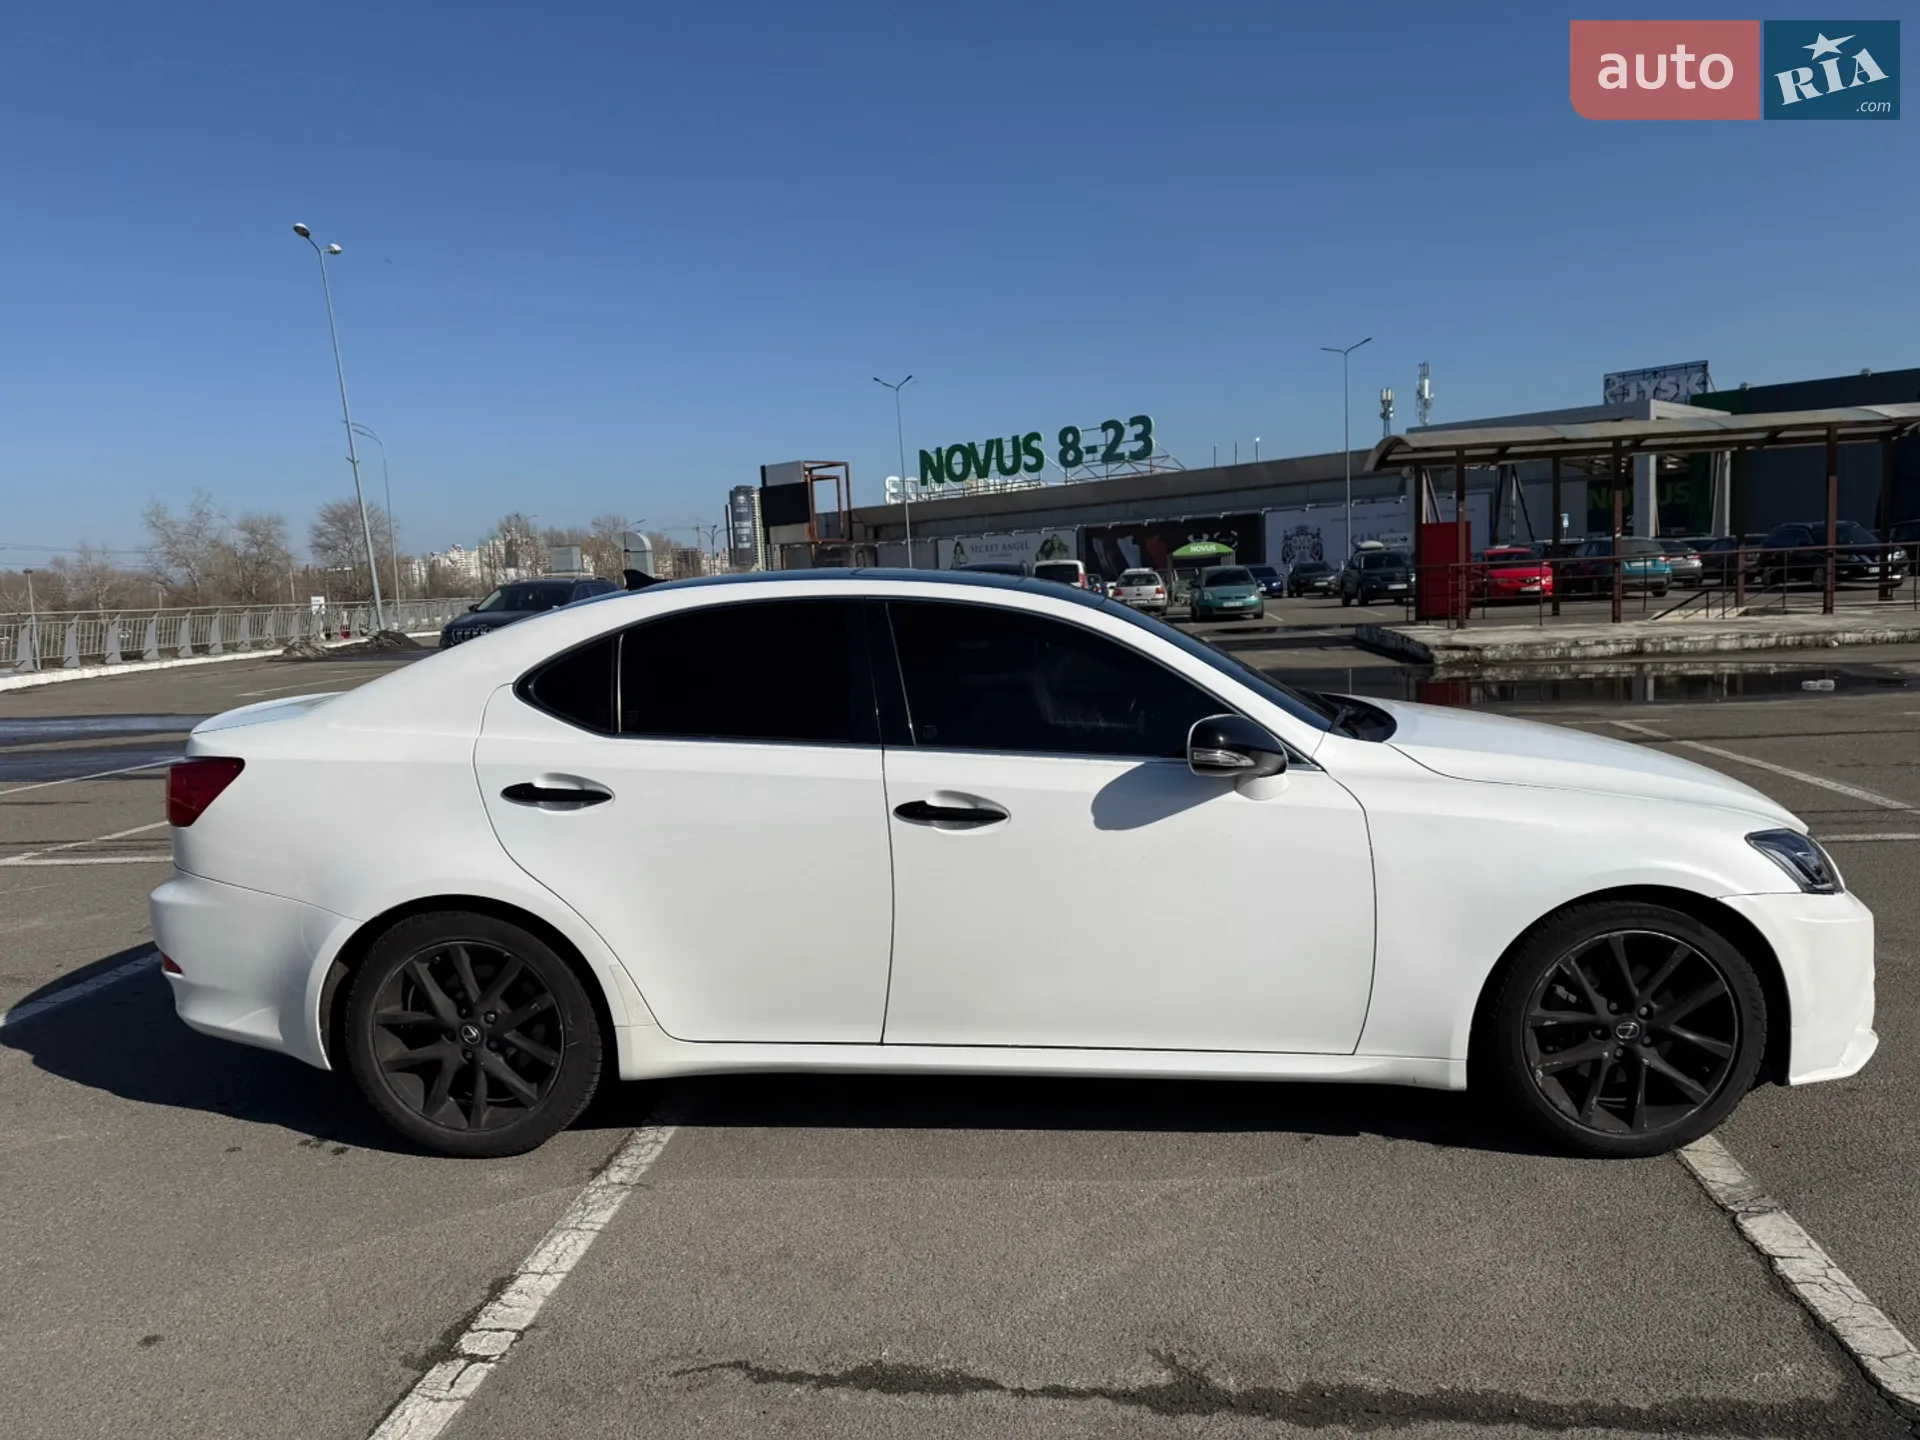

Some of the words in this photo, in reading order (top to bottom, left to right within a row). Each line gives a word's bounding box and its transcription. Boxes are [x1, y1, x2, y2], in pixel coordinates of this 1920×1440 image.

[1624, 372, 1703, 403] JYSK
[919, 431, 1045, 487] NOVUS
[1058, 415, 1154, 469] 8-23
[1588, 480, 1691, 511] NOUS
[970, 543, 999, 554] SECRET
[1002, 540, 1030, 552] ANGEL
[1190, 544, 1216, 553] NOVUS
